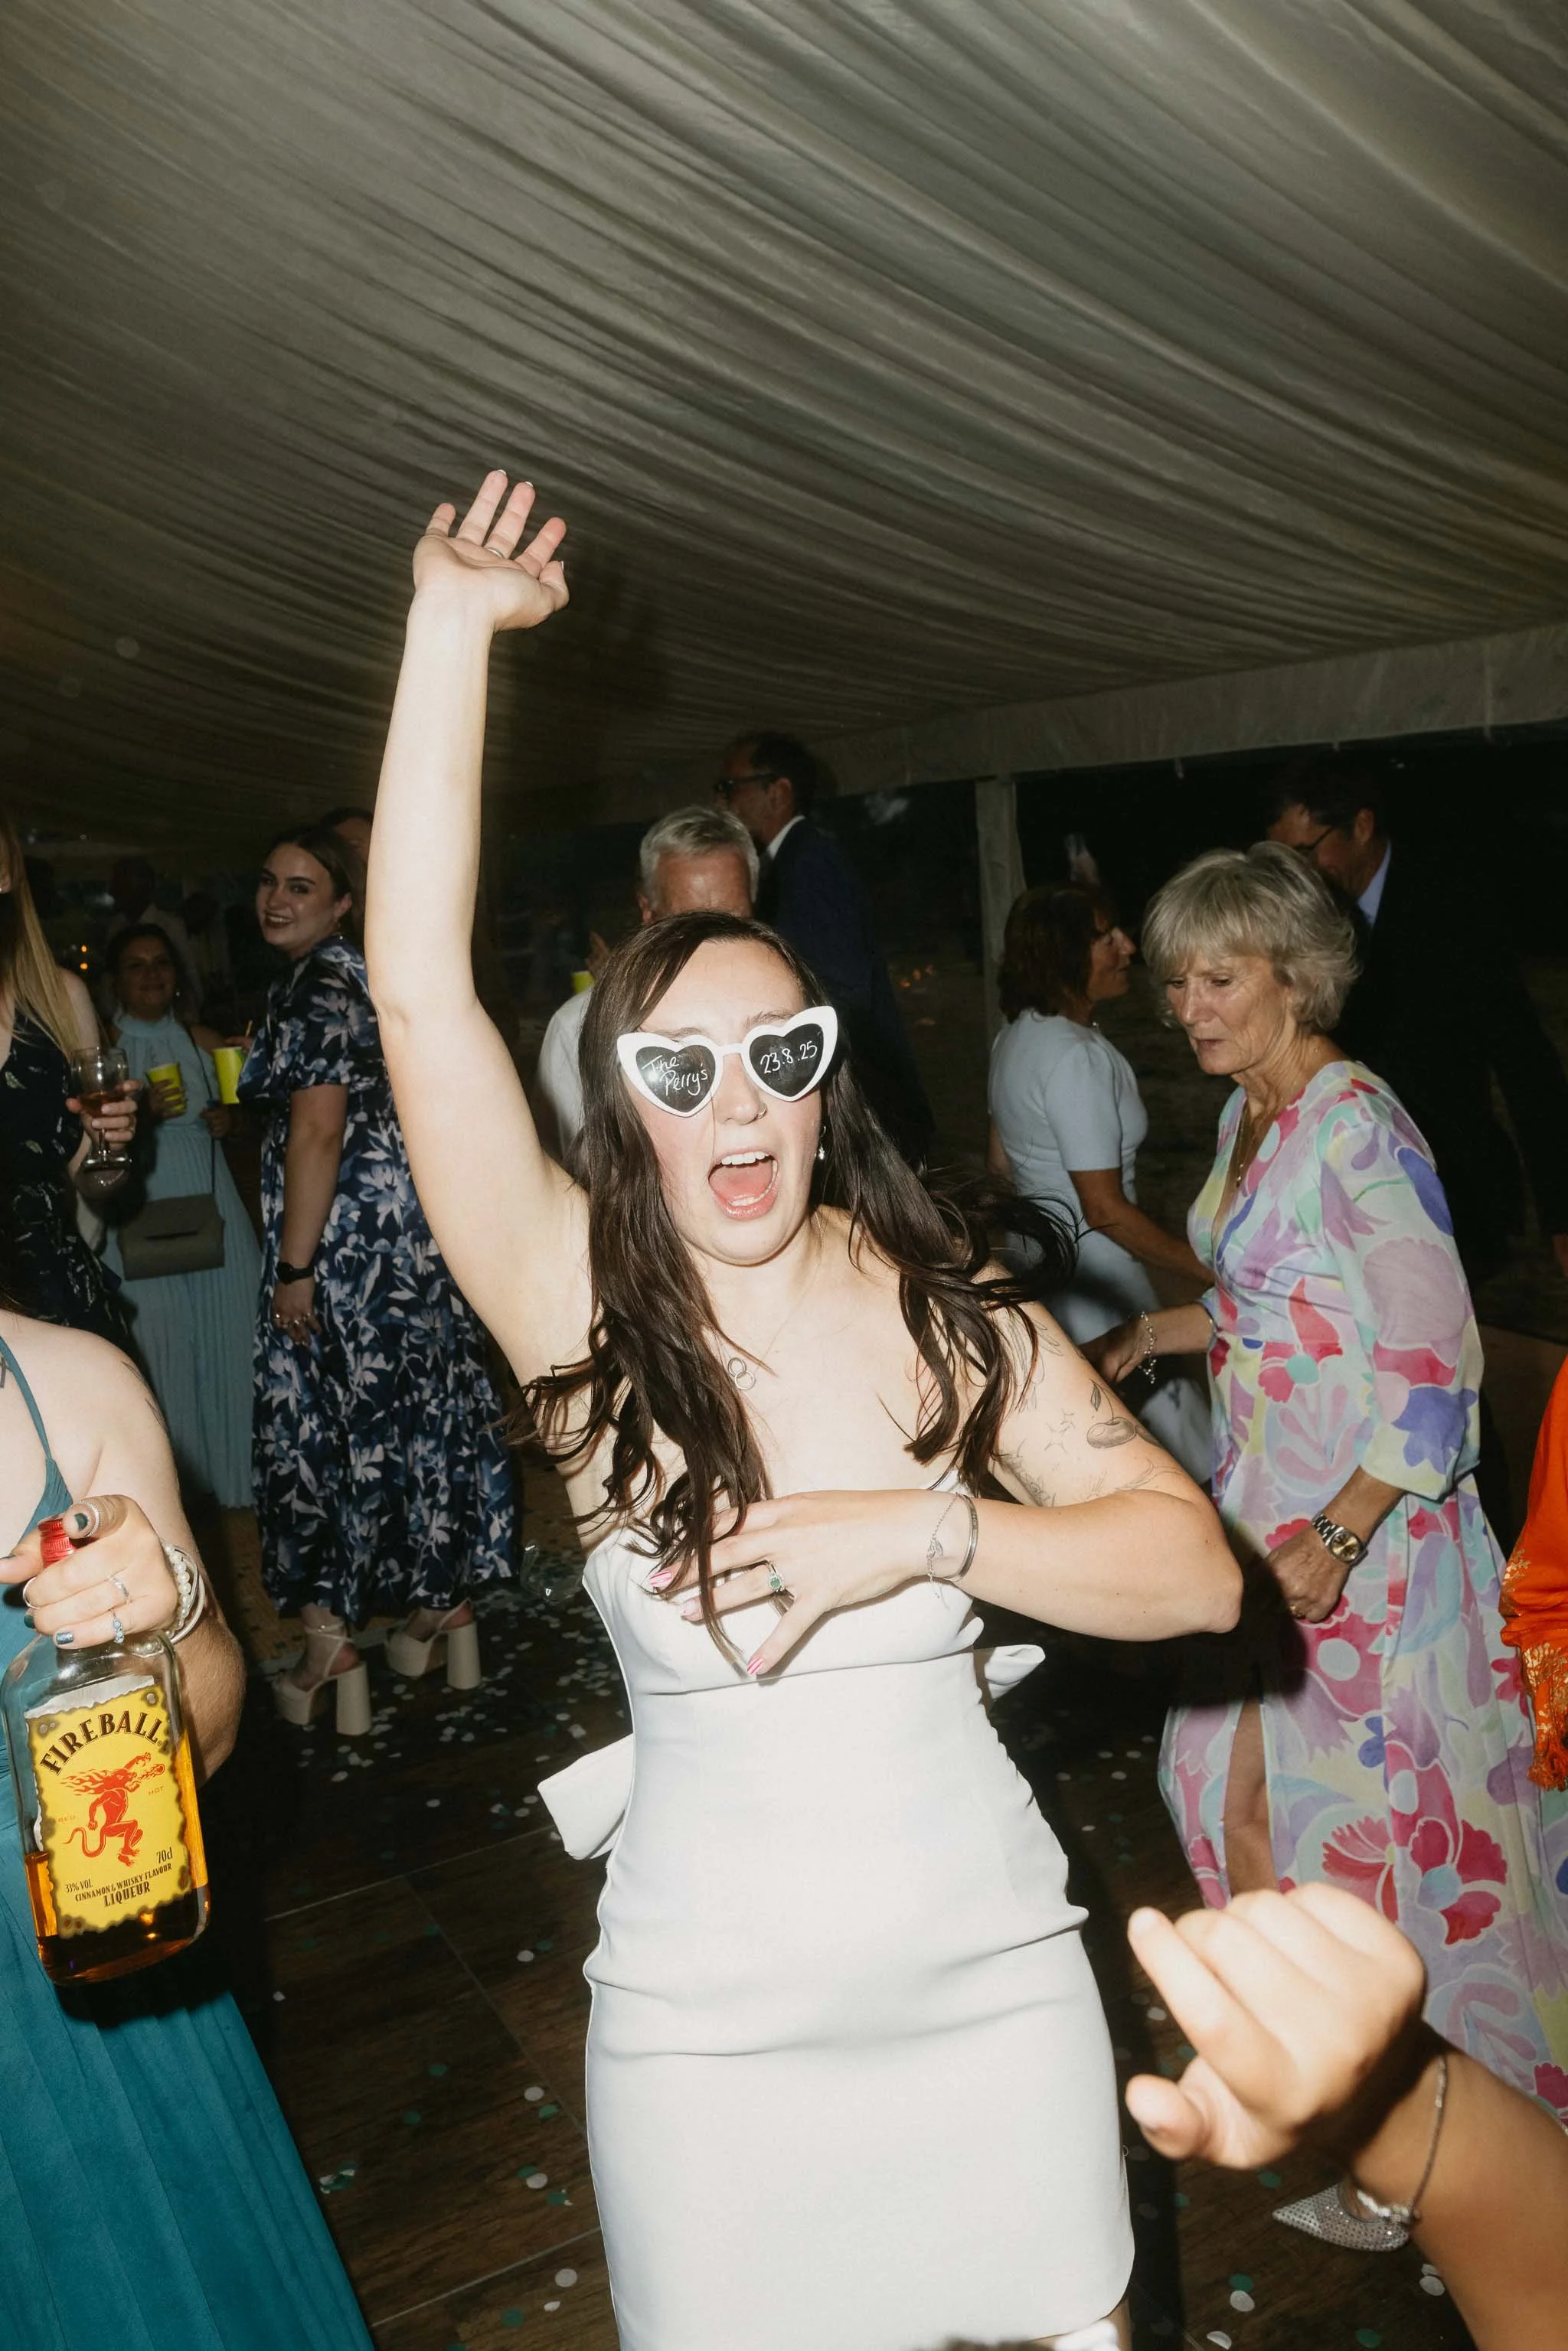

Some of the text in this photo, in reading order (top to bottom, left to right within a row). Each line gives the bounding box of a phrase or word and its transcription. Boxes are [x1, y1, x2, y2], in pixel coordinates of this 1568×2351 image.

[760, 1041, 818, 1073] 23.8.25
[661, 1063, 708, 1096] Perry's
[40, 1710, 163, 1776] FIREBALL
[149, 1786, 164, 1795] HOT
[156, 1847, 173, 1864] 70cl
[66, 1879, 79, 1893] 33%
[75, 1863, 172, 1902] CINNAMON & WHISKY FLAVOUR
[104, 1881, 151, 1907] LIQUEUR
